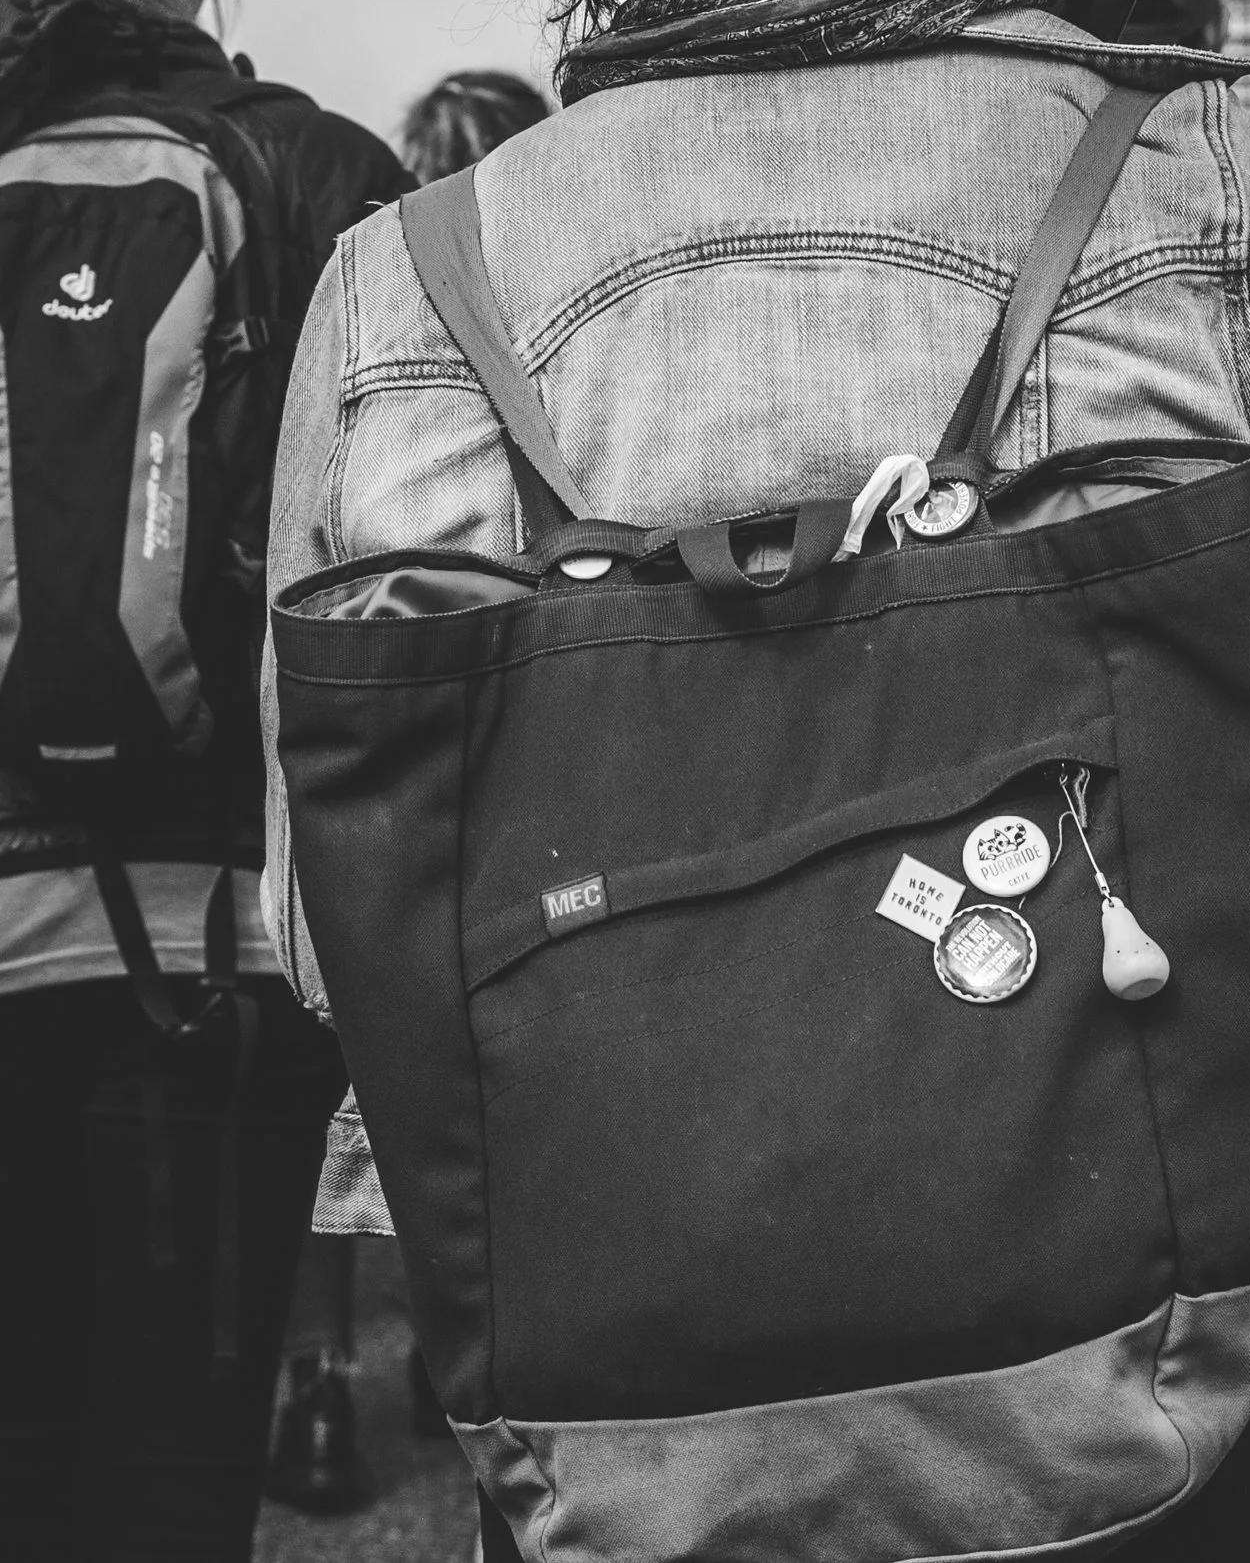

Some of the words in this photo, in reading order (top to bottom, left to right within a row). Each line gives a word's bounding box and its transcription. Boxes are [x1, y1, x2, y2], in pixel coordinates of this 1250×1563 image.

[42, 299, 113, 321] deuter
[955, 482, 968, 515] POVERT
[980, 844, 1043, 881] PURRRIDE
[547, 884, 601, 919] MEC
[908, 877, 944, 902] HOME
[915, 893, 927, 905] IS
[891, 892, 942, 926] TORONTO
[951, 937, 976, 962] CAN
[968, 919, 992, 943] NOT
[961, 928, 1004, 971] HAPPEN
[975, 940, 1012, 979] ITHOUT
